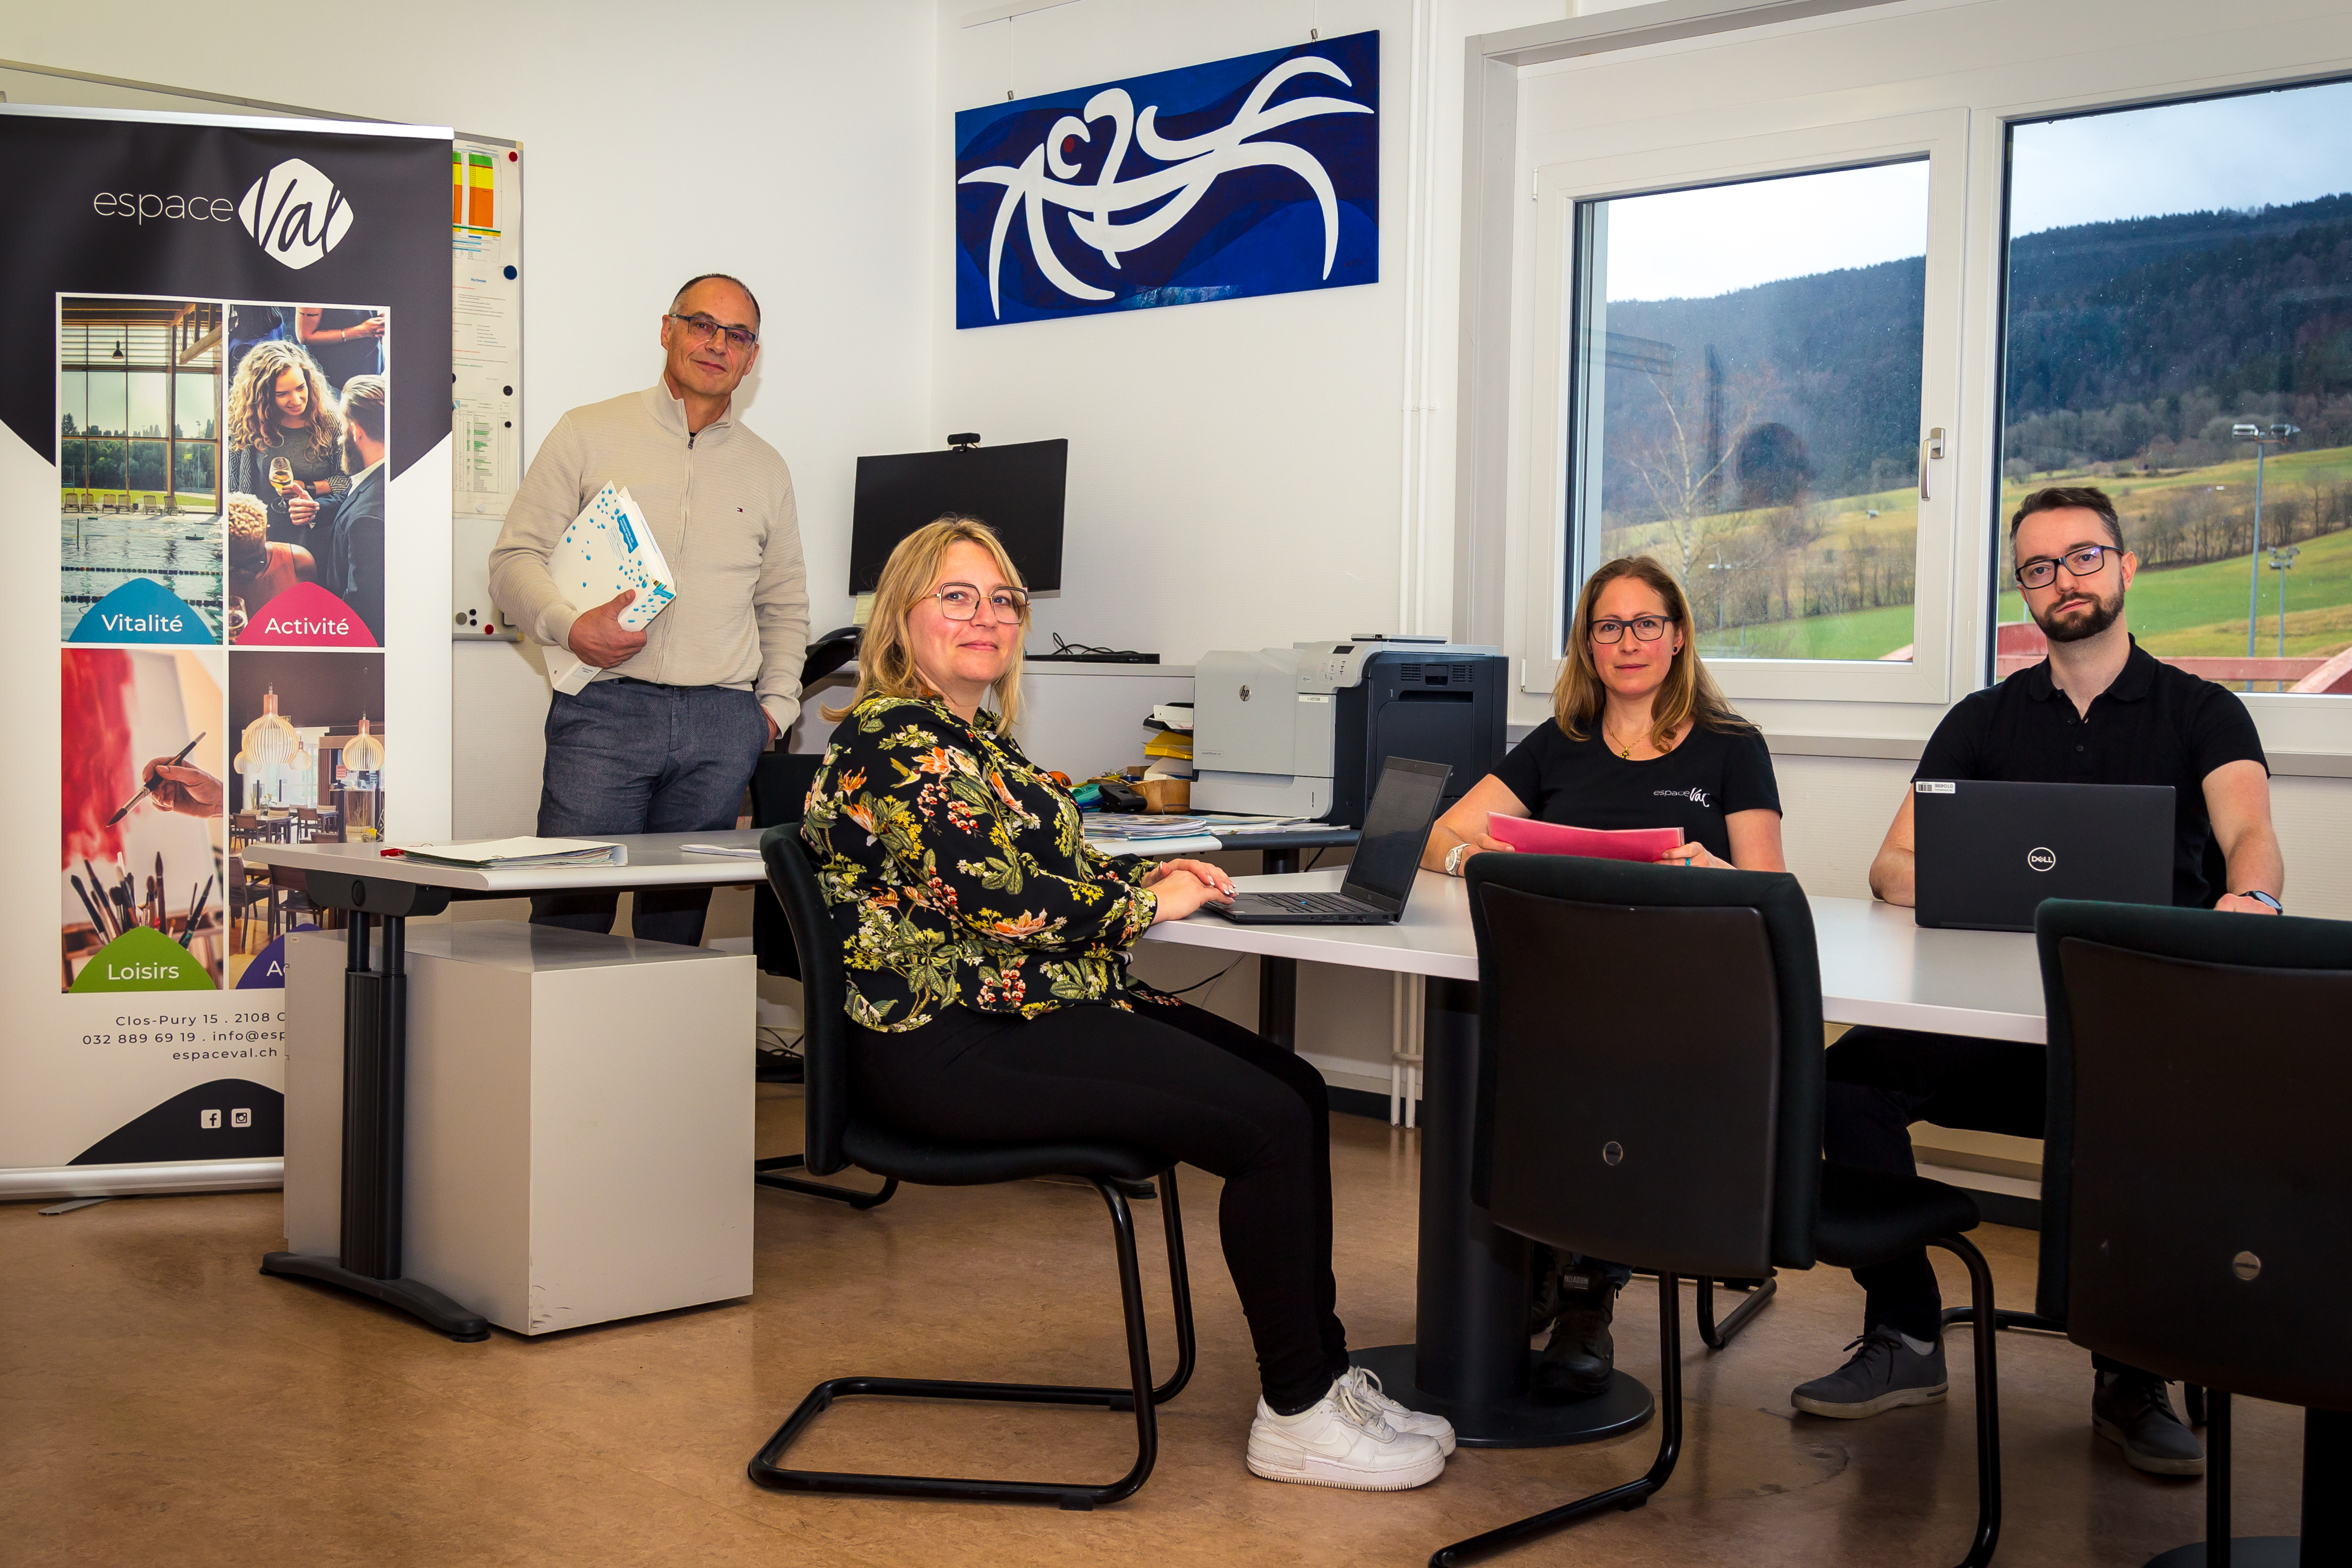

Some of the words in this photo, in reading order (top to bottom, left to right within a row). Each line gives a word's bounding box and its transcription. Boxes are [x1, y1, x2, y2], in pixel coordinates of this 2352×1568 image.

[94, 193, 234, 225] espace
[252, 169, 345, 257] Val
[102, 614, 183, 632] Vitalité
[264, 618, 350, 636] Activité
[1241, 685, 1250, 701] hp
[108, 962, 180, 981] Loisirs
[266, 960, 285, 977] A
[116, 1015, 197, 1027] Clos-Pury
[204, 1015, 218, 1024] 15
[235, 1013, 270, 1023] 2108
[83, 1035, 111, 1045] 032
[118, 1034, 148, 1044] 889
[155, 1033, 174, 1043] 69
[181, 1032, 196, 1042] 19
[173, 1048, 278, 1061] espaceval.ch
[1564, 1275, 1588, 1285] PALLADIUM
